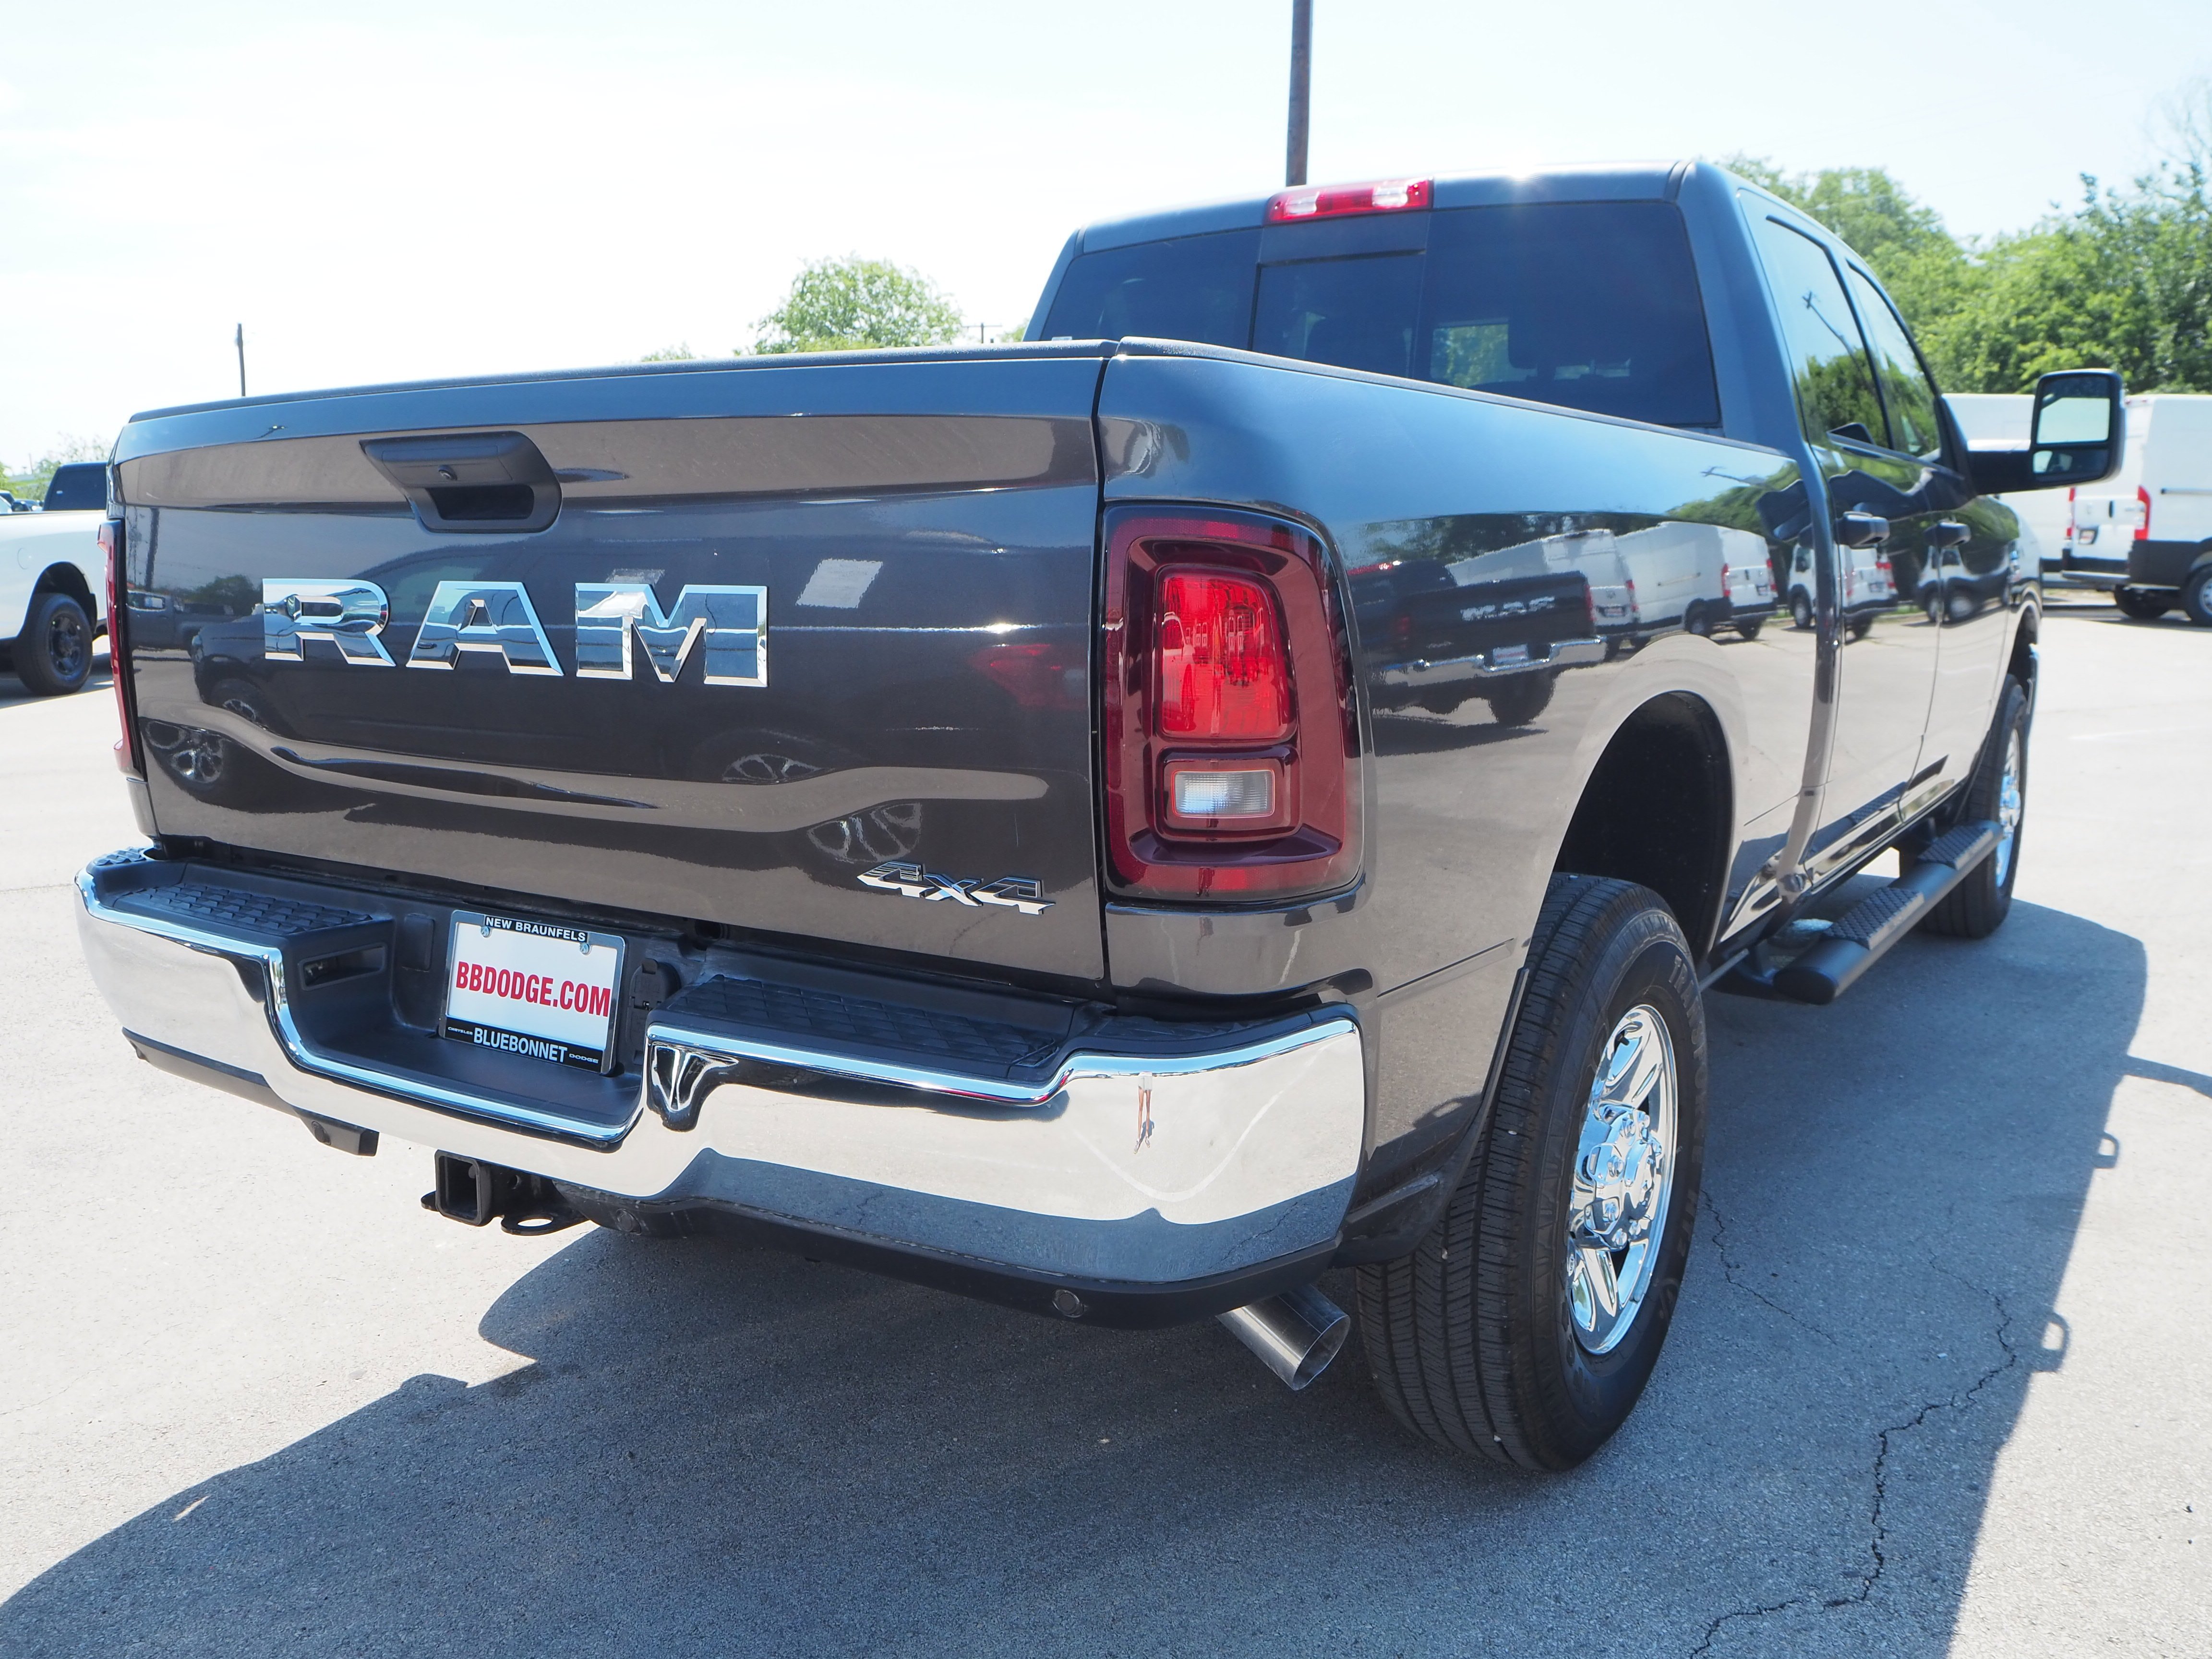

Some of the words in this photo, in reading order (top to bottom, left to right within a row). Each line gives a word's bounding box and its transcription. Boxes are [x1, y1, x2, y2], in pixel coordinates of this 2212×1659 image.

[262, 578, 769, 687] RAM
[485, 916, 512, 929] NEW
[515, 922, 586, 942] BRAUNFELS
[456, 961, 611, 1017] BBDODGE.COM
[447, 1026, 473, 1035] CHRYSLER
[473, 1027, 568, 1063] BLUEBONNET
[569, 1053, 599, 1064] DODGE
